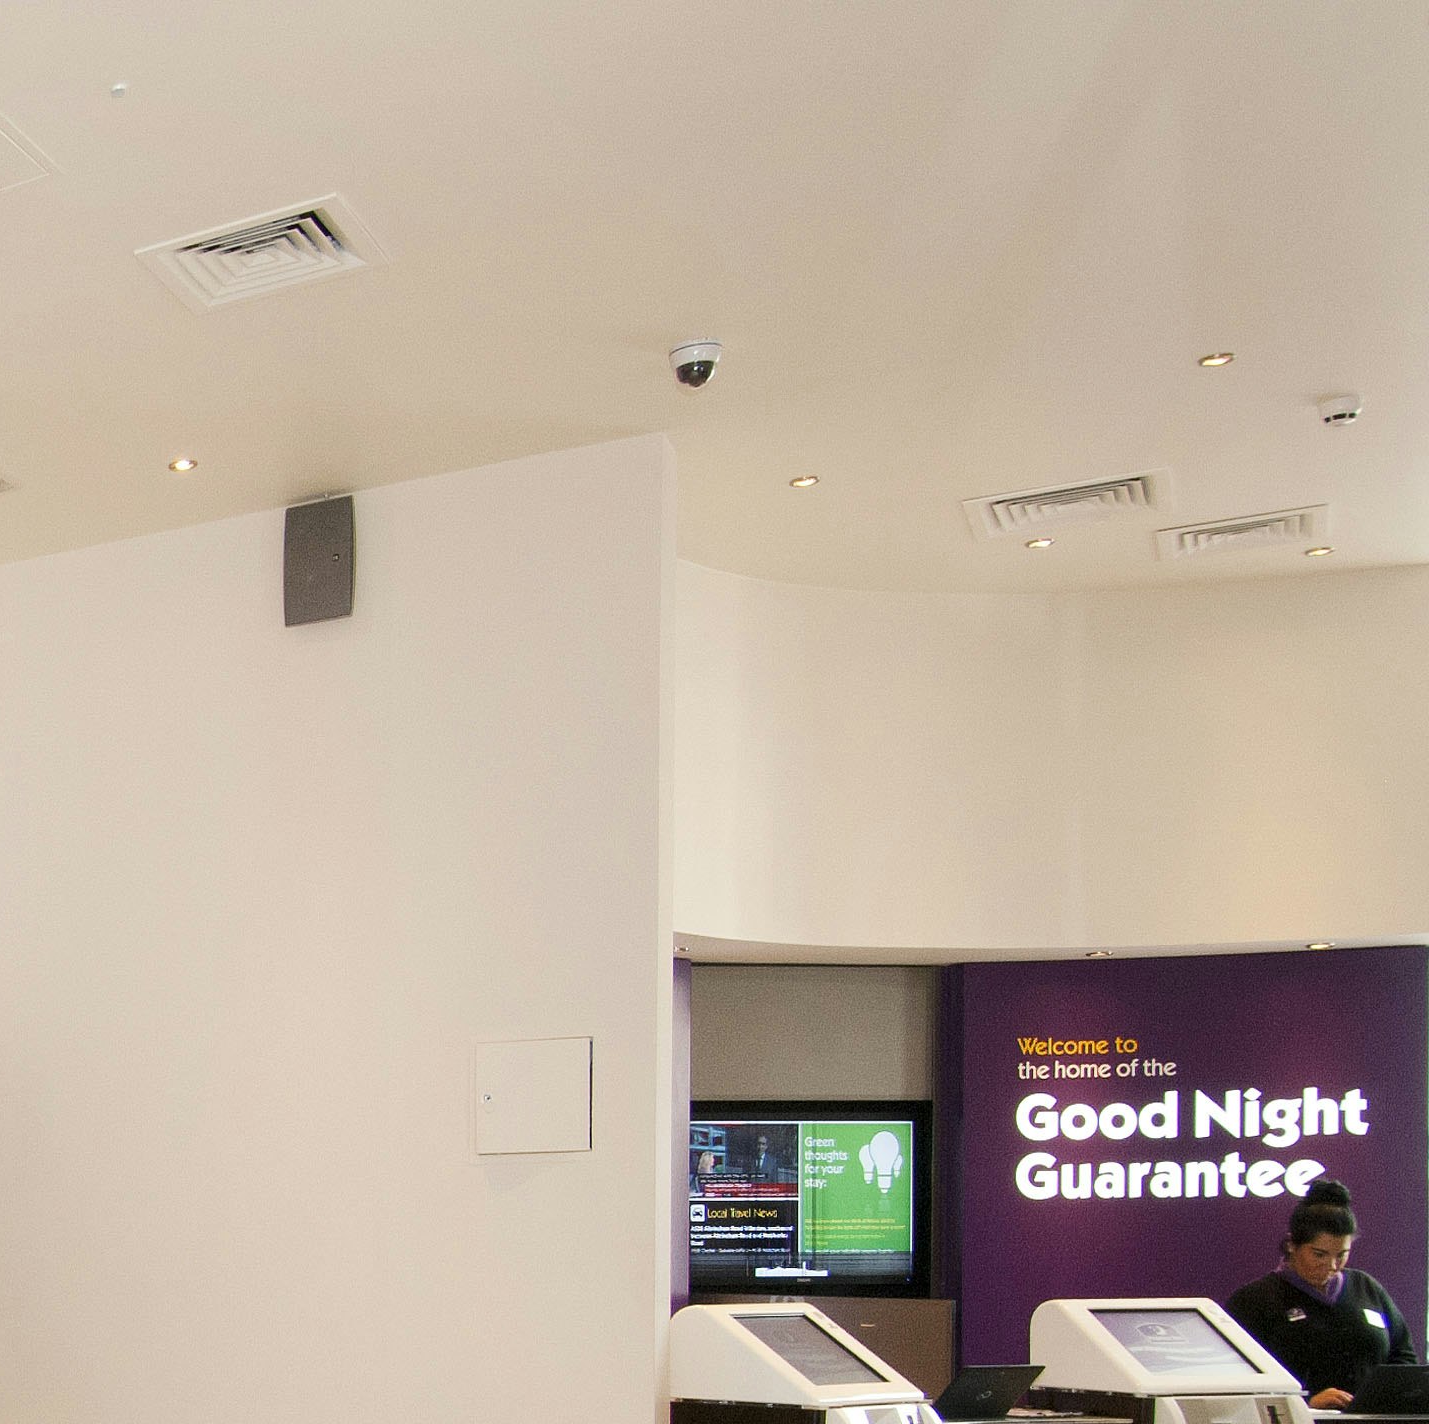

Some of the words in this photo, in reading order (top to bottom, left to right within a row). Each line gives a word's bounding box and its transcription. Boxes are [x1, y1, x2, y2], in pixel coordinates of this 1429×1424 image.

[1017, 1037, 1110, 1055] Welcome
[1115, 1036, 1139, 1054] to
[1017, 1061, 1050, 1080] the
[1054, 1060, 1111, 1079] home
[1116, 1059, 1139, 1078] of
[1143, 1058, 1177, 1077] the
[1015, 1090, 1180, 1141] Good
[1194, 1086, 1370, 1148] Night
[804, 1137, 835, 1147] Green
[804, 1150, 848, 1162] thoughts
[804, 1164, 819, 1174] for
[820, 1165, 844, 1175] your
[1015, 1151, 1326, 1200] Guarantee
[707, 1208, 728, 1219] Local
[730, 1208, 751, 1219] Travel
[754, 1208, 778, 1218] News
